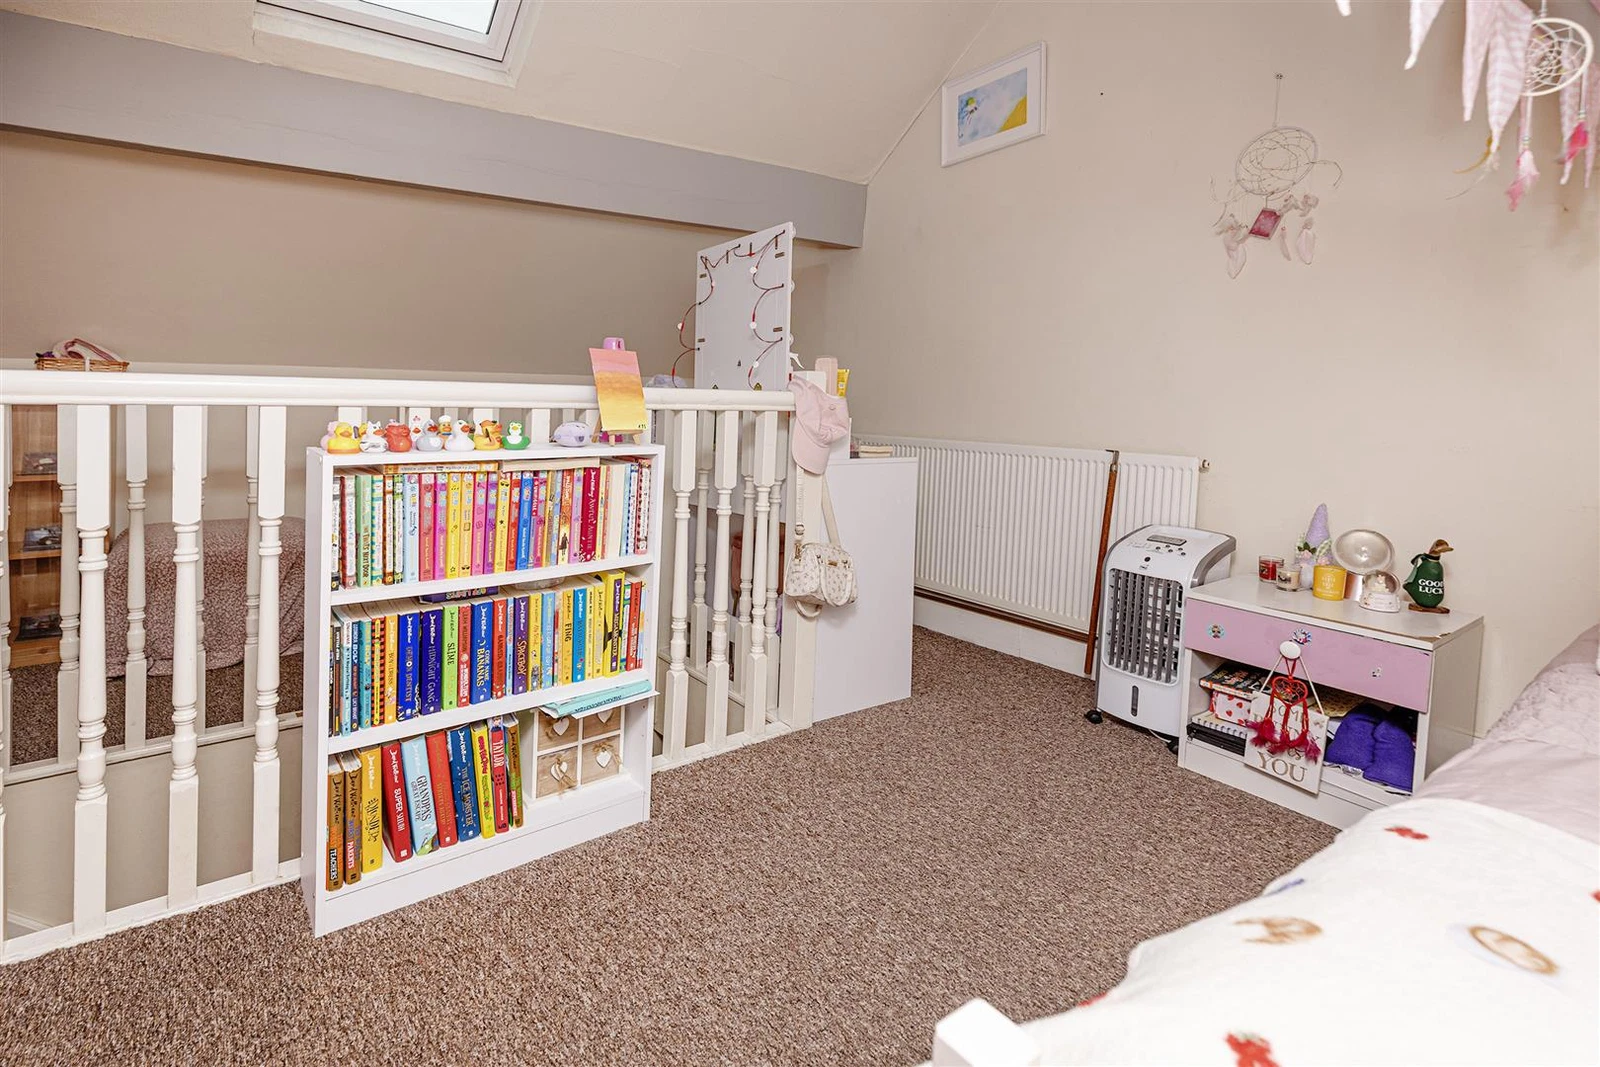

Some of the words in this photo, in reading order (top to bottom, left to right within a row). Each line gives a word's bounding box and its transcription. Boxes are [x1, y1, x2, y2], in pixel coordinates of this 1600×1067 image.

[564, 623, 572, 642] FING
[405, 647, 413, 672] DEMON
[427, 645, 436, 680] MIDNIGHT
[447, 642, 455, 666] SLIME
[476, 648, 485, 687] BANANAS
[516, 640, 527, 676] SPACEBOY
[427, 682, 436, 703] GANG
[493, 739, 504, 768] TAYLOR
[1257, 751, 1308, 783] YOU
[394, 788, 402, 812] SUPER
[411, 781, 419, 800] GREAT
[417, 775, 432, 822] GRANDPA'S
[461, 780, 471, 793] ICE
[463, 793, 474, 827] MONSTER
